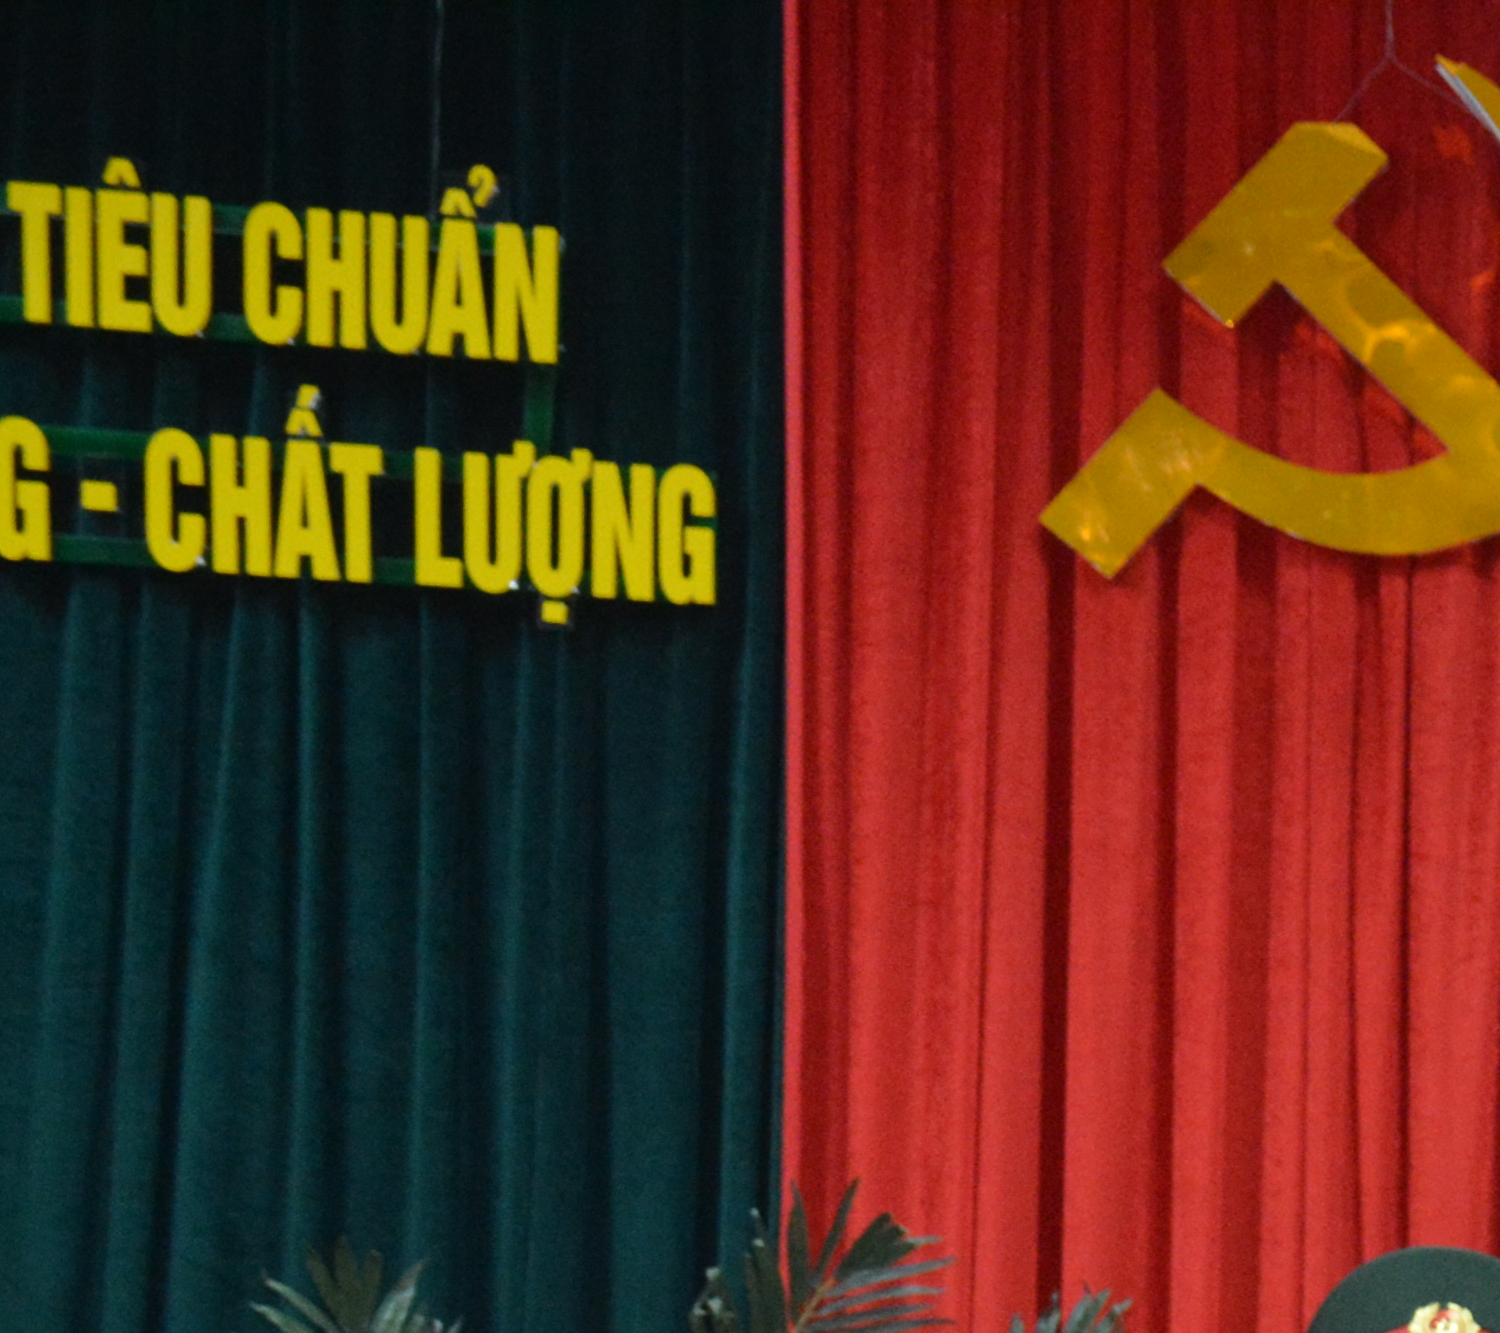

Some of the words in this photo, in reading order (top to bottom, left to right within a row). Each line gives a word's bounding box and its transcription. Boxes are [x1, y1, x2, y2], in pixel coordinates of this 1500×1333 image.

[6, 157, 212, 337] TIÊU
[243, 165, 559, 363] CHUẨN
[145, 385, 383, 583] CHẤT
[414, 440, 715, 624] LƯỢNG
